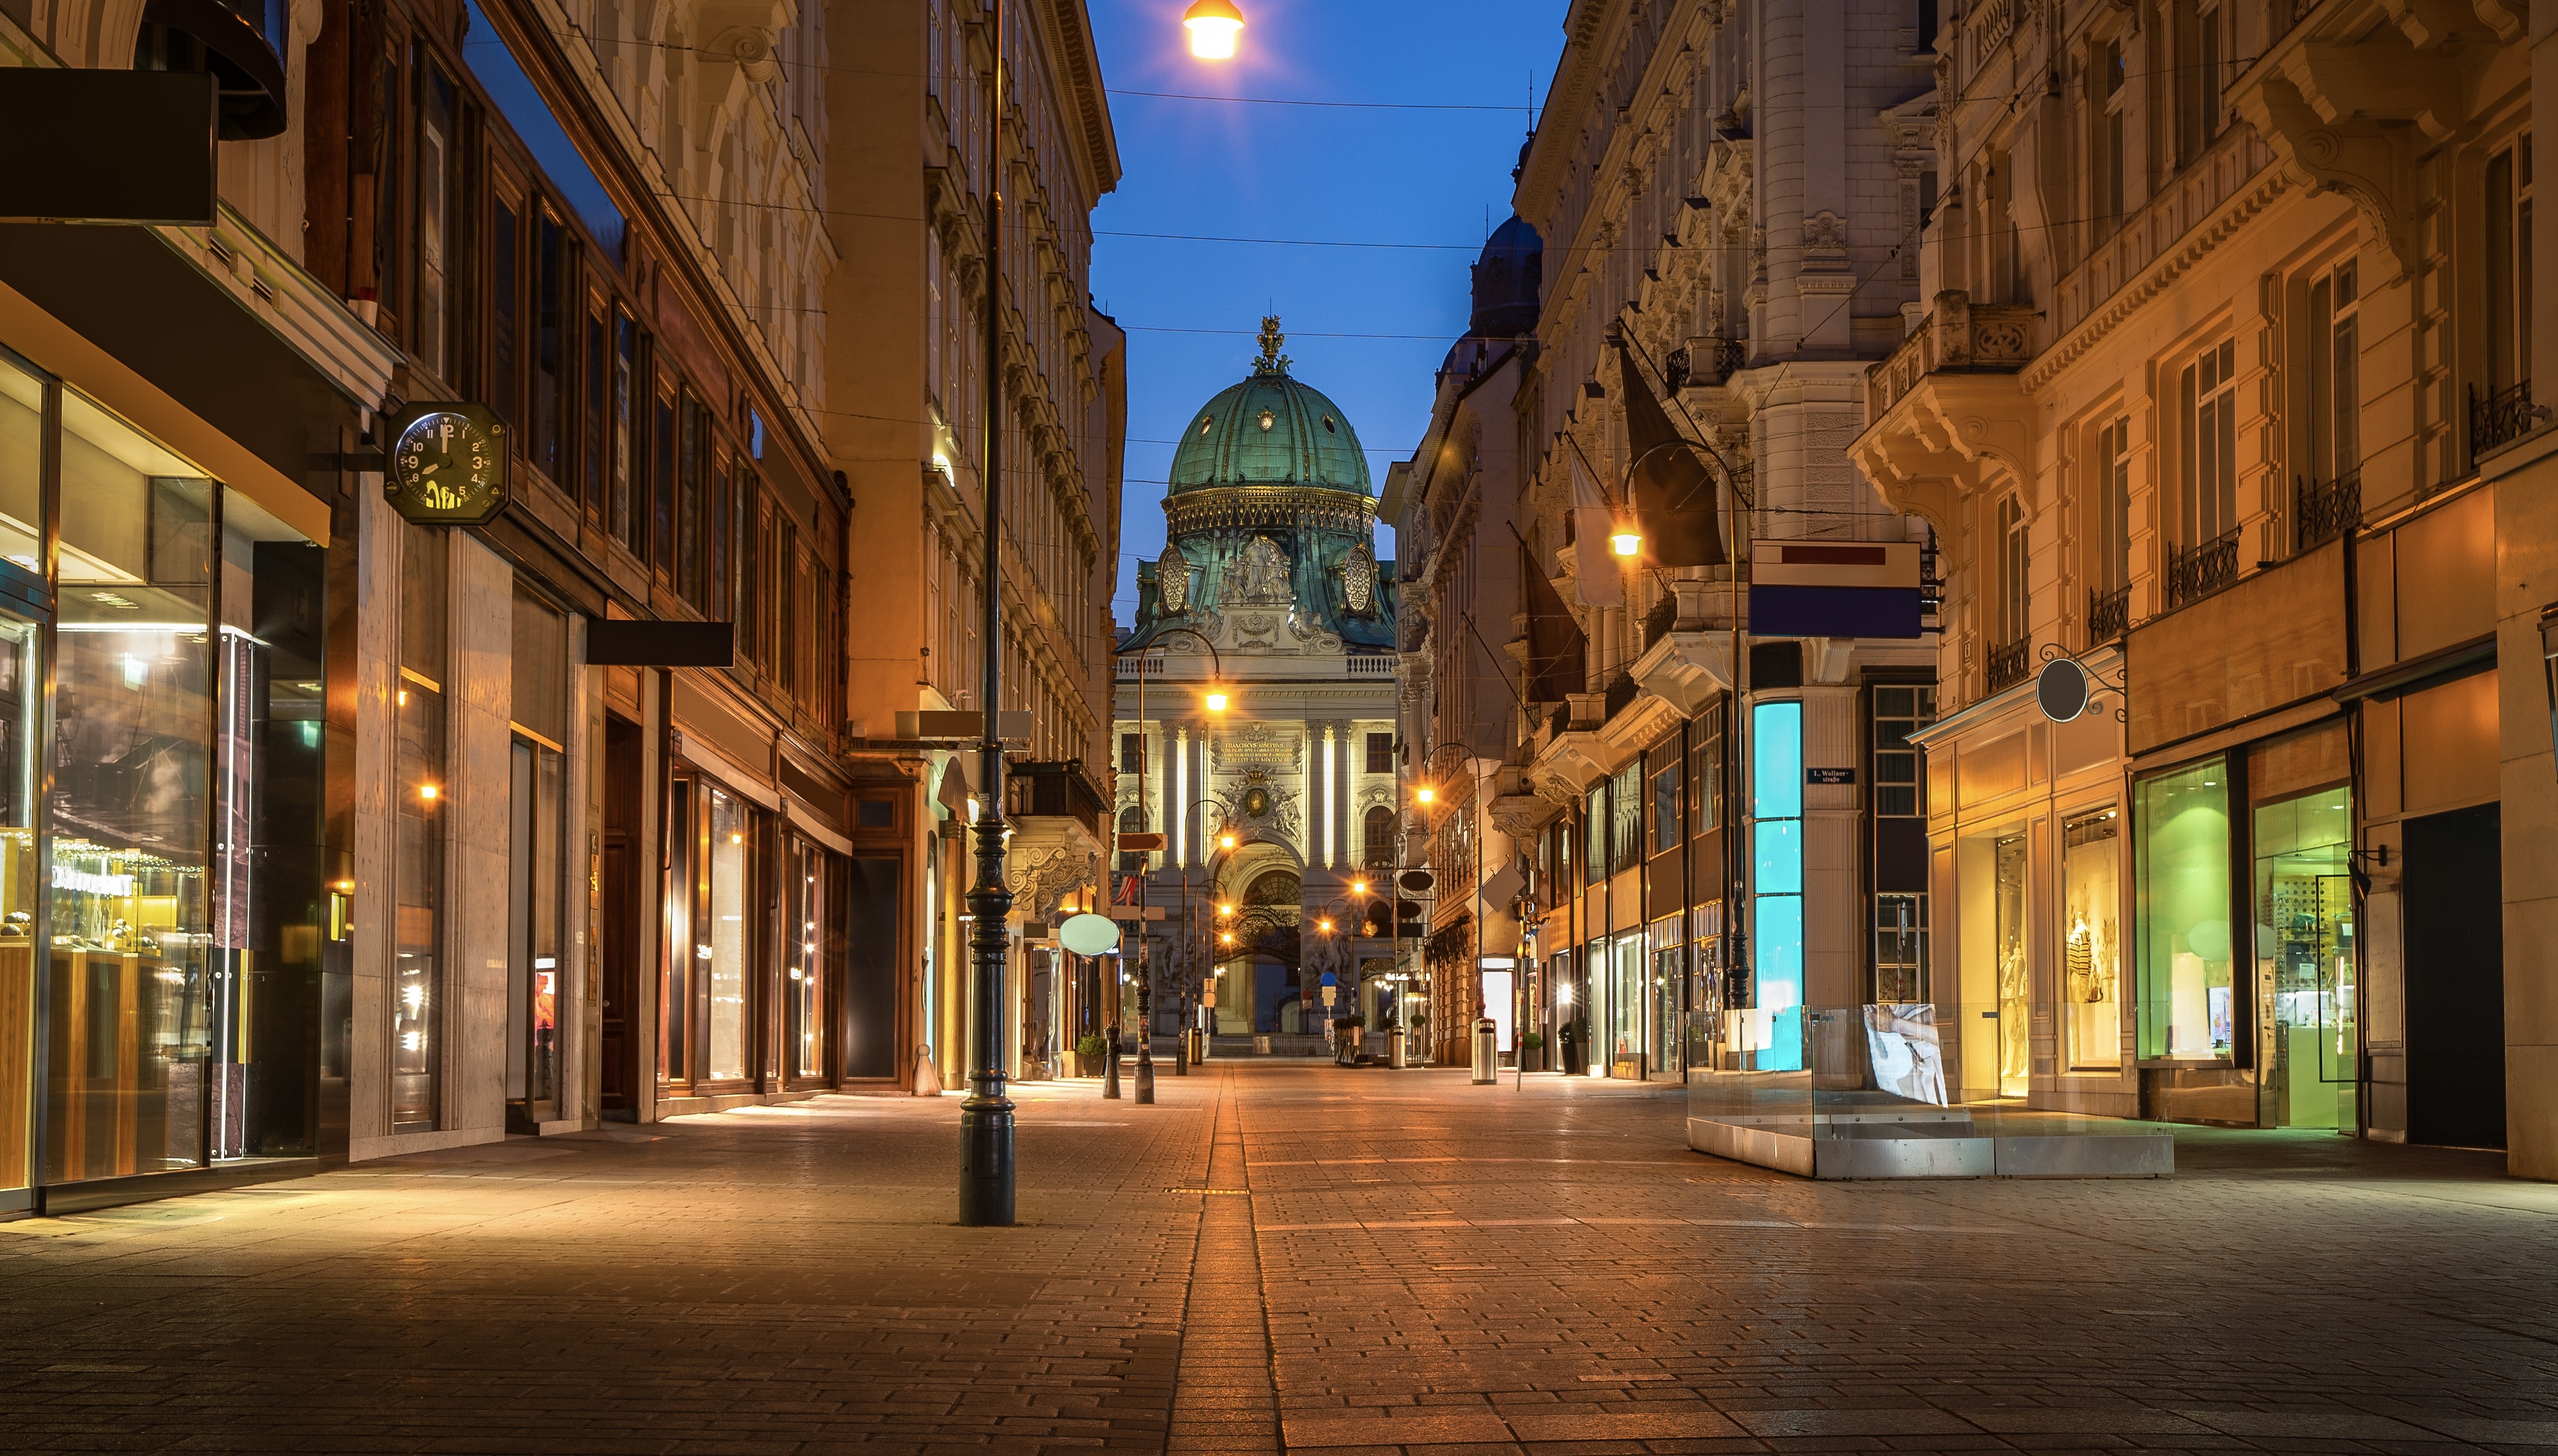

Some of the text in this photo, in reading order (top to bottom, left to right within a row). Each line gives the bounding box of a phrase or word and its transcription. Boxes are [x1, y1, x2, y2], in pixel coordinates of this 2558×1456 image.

[427, 430, 433, 438] 11
[462, 430, 465, 438] 1
[413, 442, 423, 452] 10
[472, 442, 479, 452] 2
[408, 456, 418, 468] 9
[472, 456, 482, 469] 3
[412, 473, 418, 482] 8
[471, 473, 478, 483] 4
[440, 486, 450, 499] 6
[459, 486, 466, 495] 5
